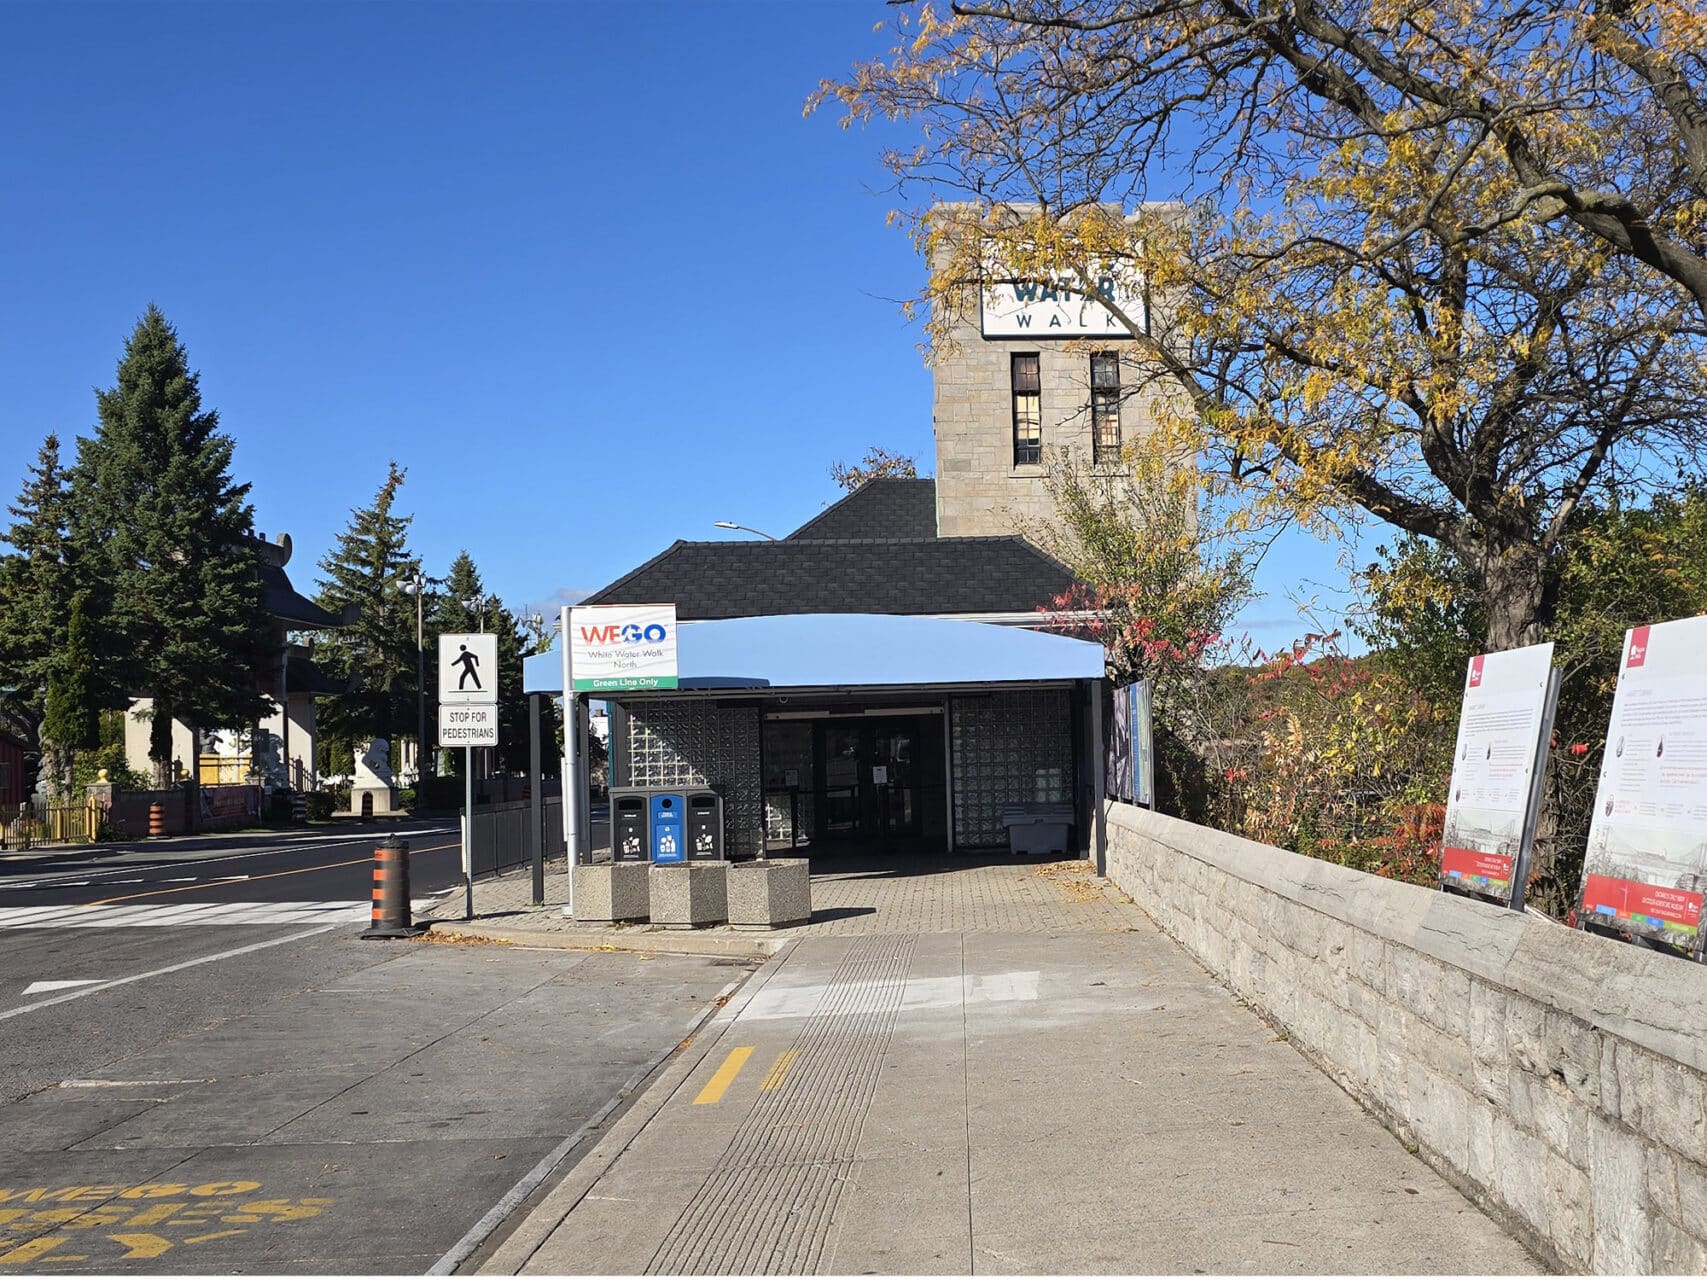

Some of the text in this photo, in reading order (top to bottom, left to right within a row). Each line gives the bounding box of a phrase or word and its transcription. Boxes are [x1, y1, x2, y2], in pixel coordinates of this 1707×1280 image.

[1016, 314, 1117, 328] WALK
[580, 623, 667, 645] WEGO
[588, 649, 664, 659] White Water Walk
[613, 661, 638, 669] North
[593, 678, 659, 687] Green Line Only
[449, 711, 487, 723] STOP FOR
[442, 727, 494, 739] PEDESTRIANS
